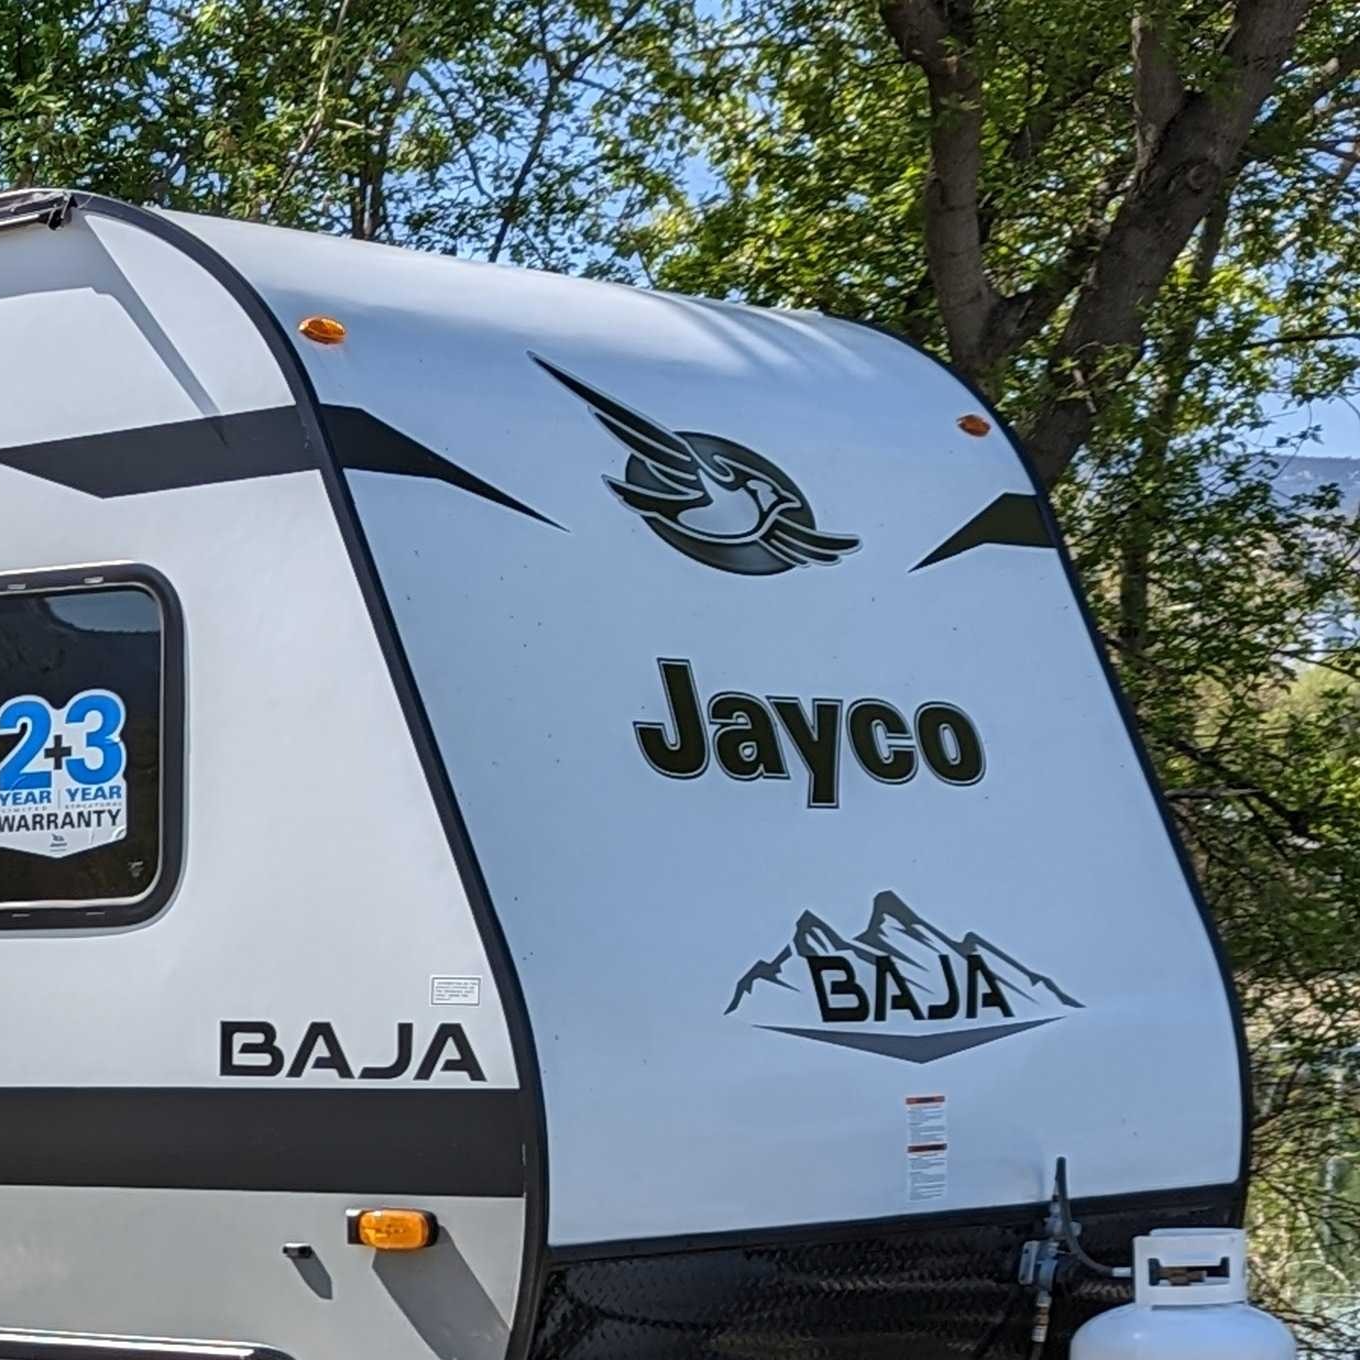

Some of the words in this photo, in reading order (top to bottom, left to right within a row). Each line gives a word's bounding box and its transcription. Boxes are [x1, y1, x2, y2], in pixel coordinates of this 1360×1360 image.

[633, 657, 986, 808] Jayco
[65, 785, 122, 802] YEAR
[806, 954, 1015, 1022] BAJA
[220, 1021, 487, 1082] BAJA
